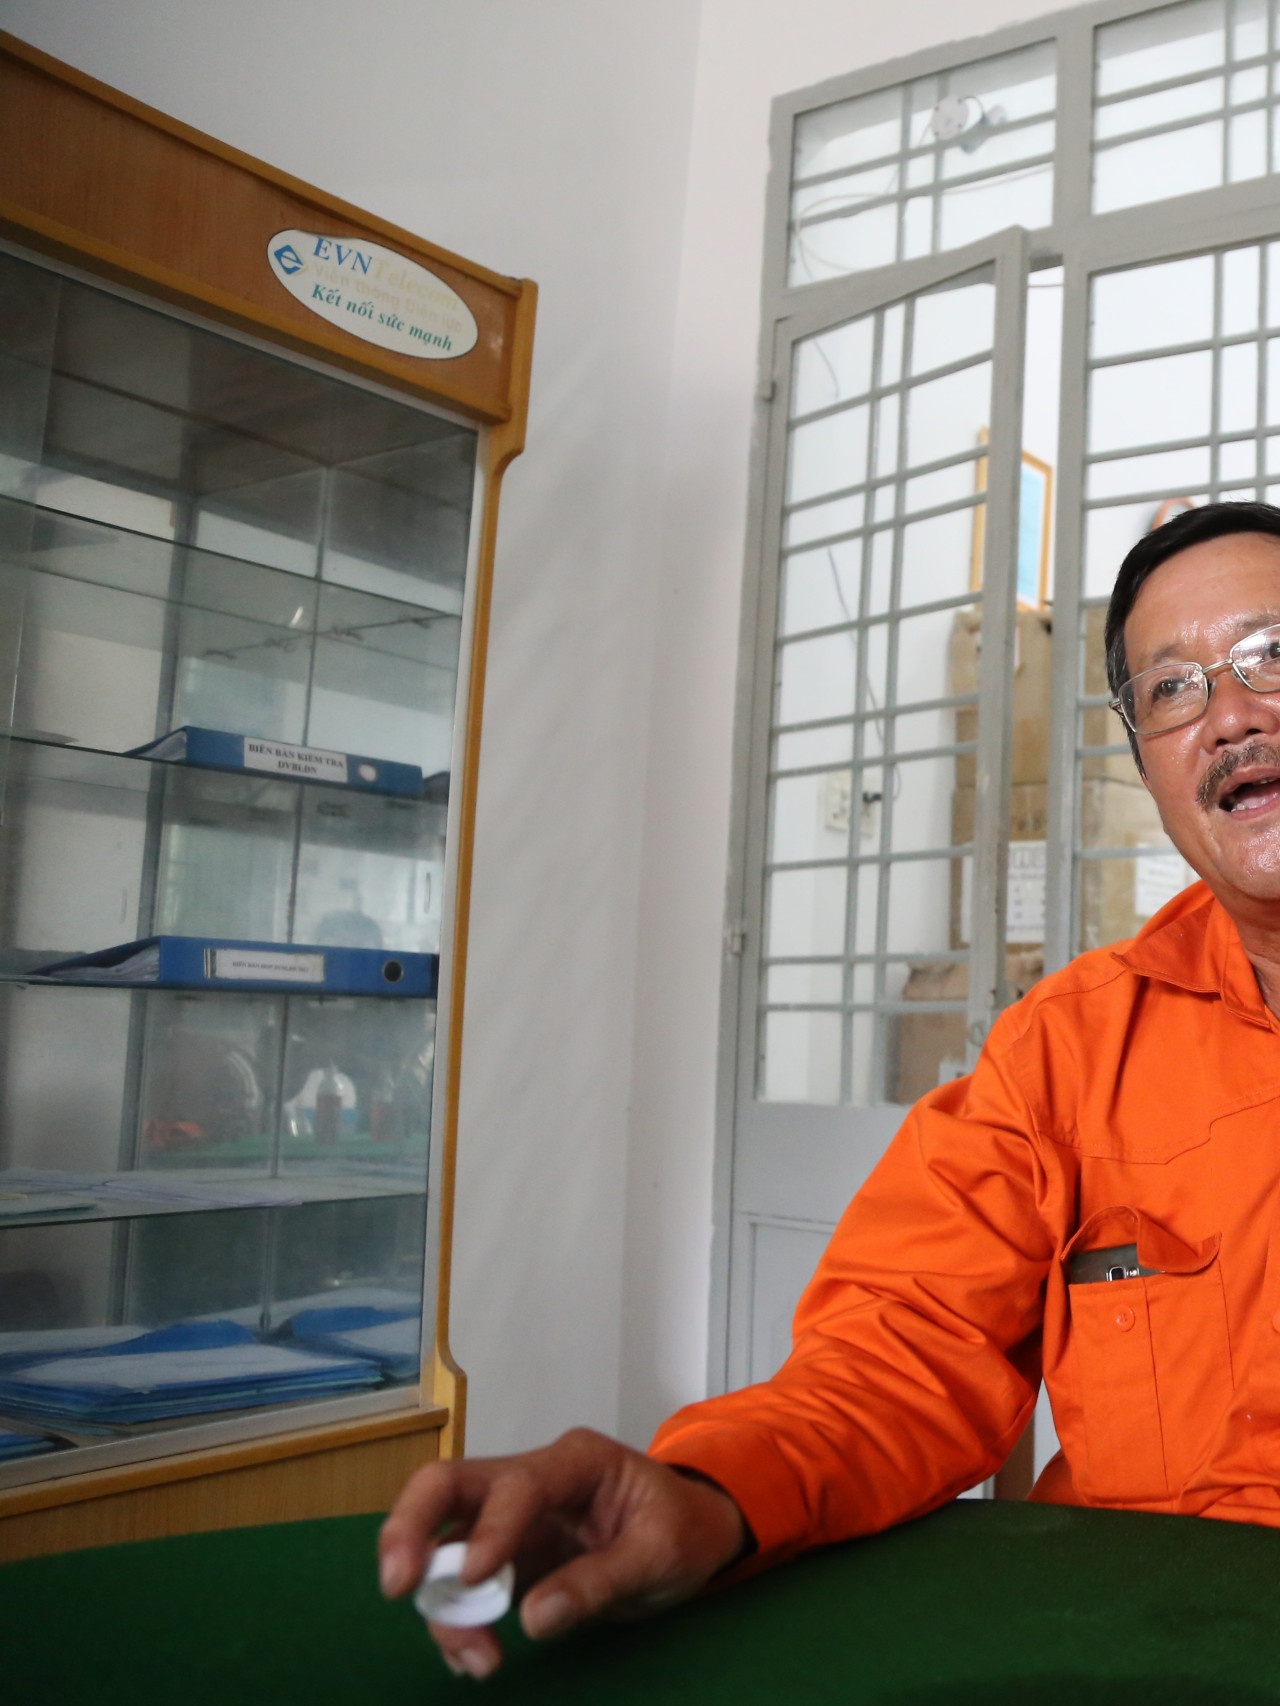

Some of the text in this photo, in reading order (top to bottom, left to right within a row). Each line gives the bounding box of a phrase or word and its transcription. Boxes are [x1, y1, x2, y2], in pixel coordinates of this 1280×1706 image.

[311, 284, 453, 352] Kết nối sức mạnh
[326, 758, 345, 768] TRA
